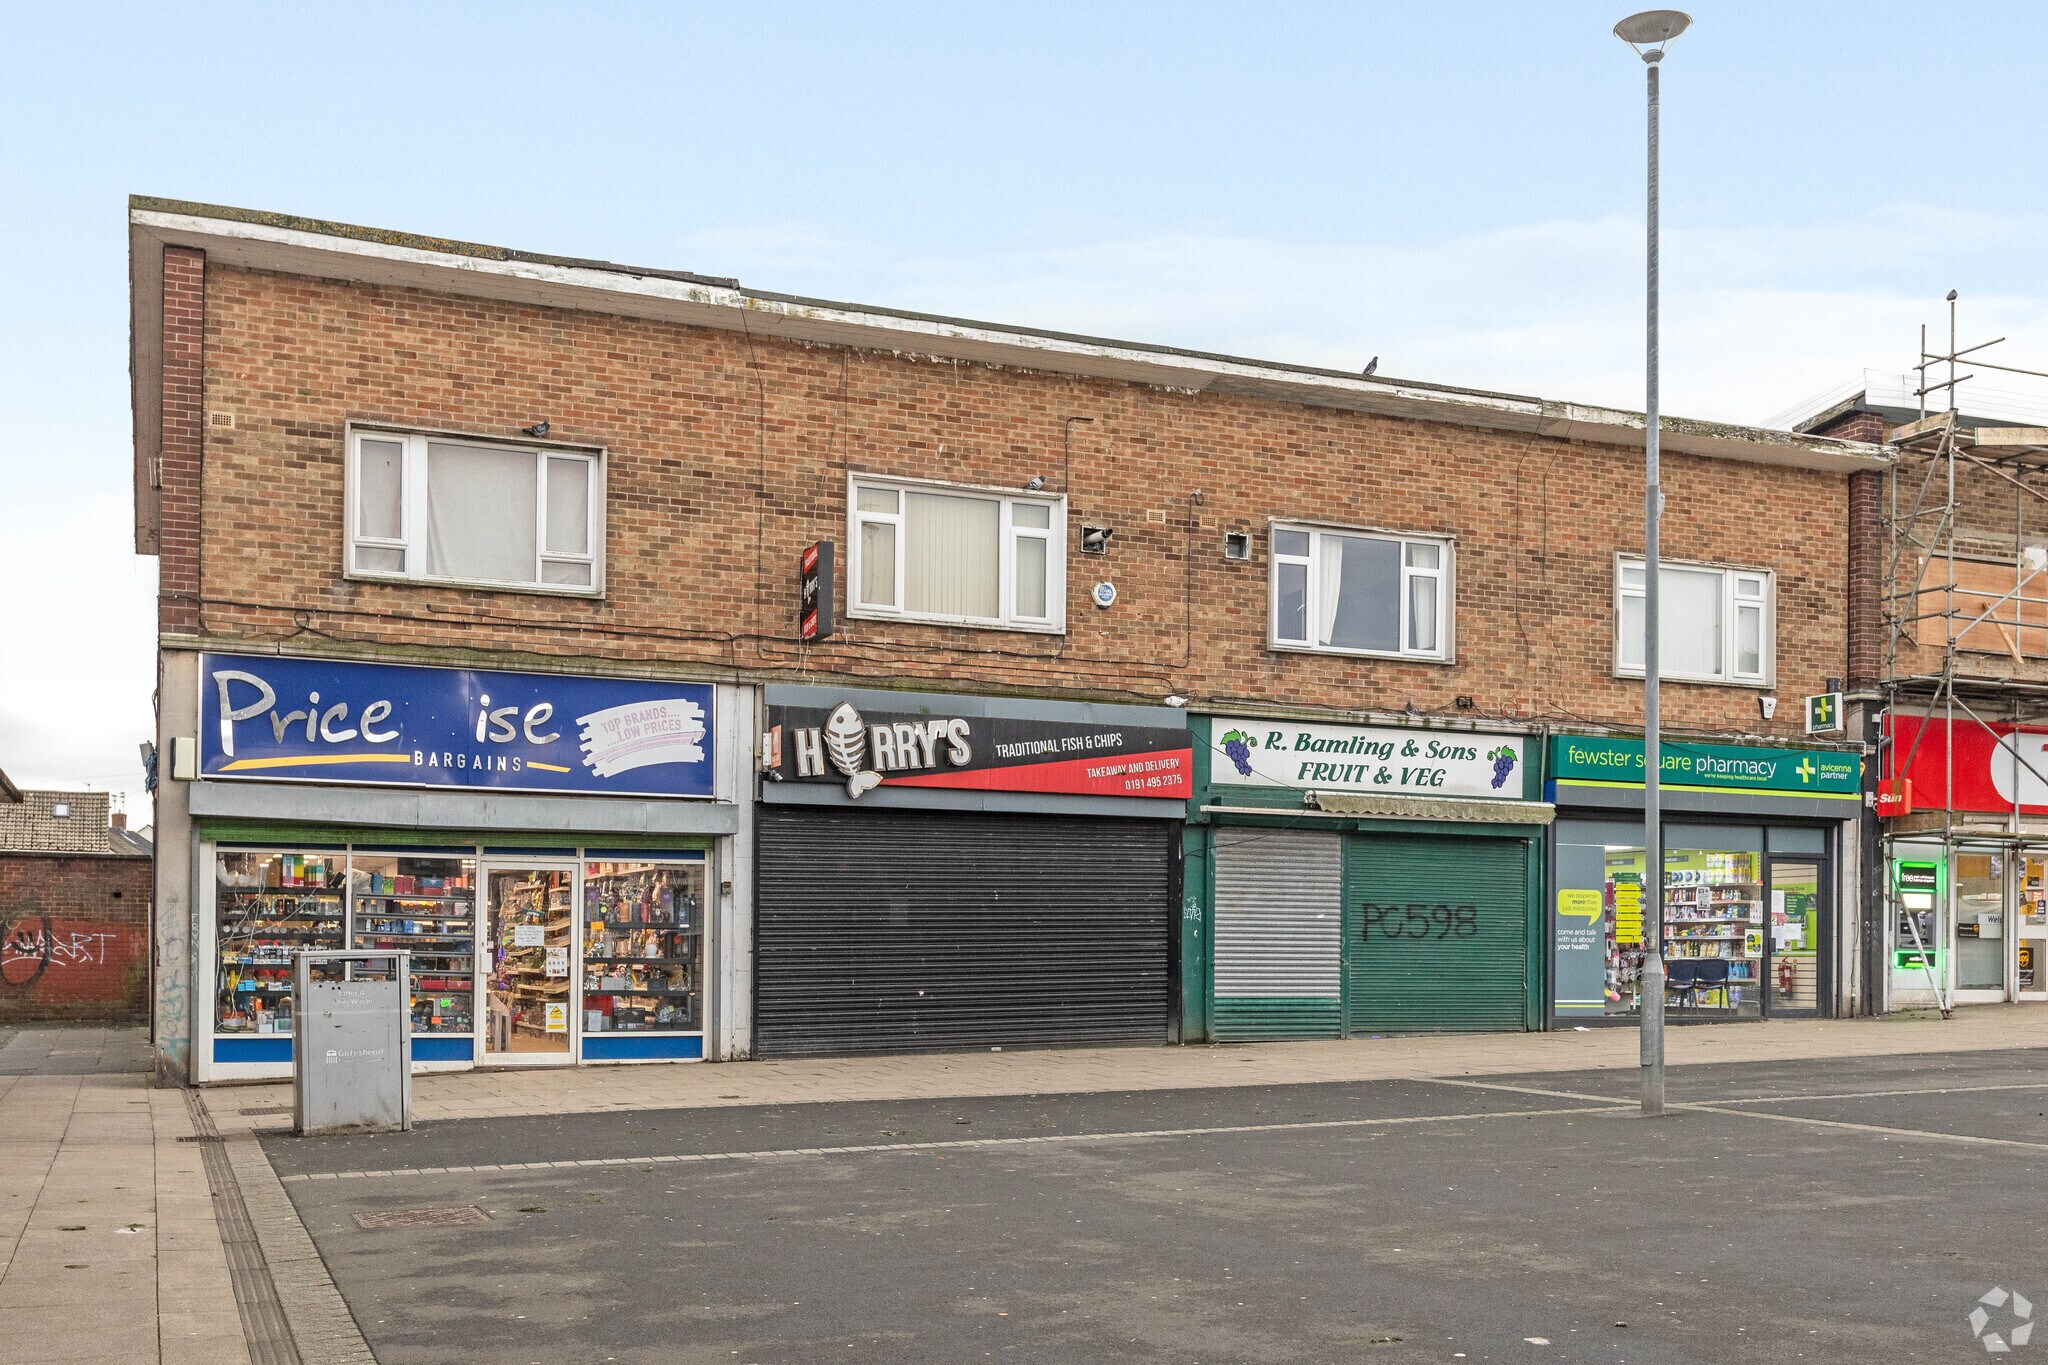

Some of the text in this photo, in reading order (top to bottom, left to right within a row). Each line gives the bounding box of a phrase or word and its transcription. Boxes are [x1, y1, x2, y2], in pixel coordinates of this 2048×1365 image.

[212, 670, 400, 757] Price
[601, 717, 621, 734] TOP
[643, 719, 682, 735] PRICES
[1813, 722, 1835, 731] pharmacy
[995, 732, 1123, 758] TRADITIONAL FISH & CHIPS
[1265, 731, 1477, 760] R. Bamling & Sons
[414, 750, 521, 772] BARGAINS
[1086, 757, 1180, 779] TAKEAWAY AND DELIVERY
[1569, 745, 1776, 778] fewster suare pharmacy
[1821, 763, 1851, 773] avicenna
[1125, 773, 1183, 790] 0191 495 2375
[1298, 762, 1446, 787] FRUIT & VEG
[1821, 771, 1848, 780] partner
[1880, 793, 1902, 803] Sun
[1902, 873, 1914, 882] free
[338, 1048, 384, 1057] Gateshead
